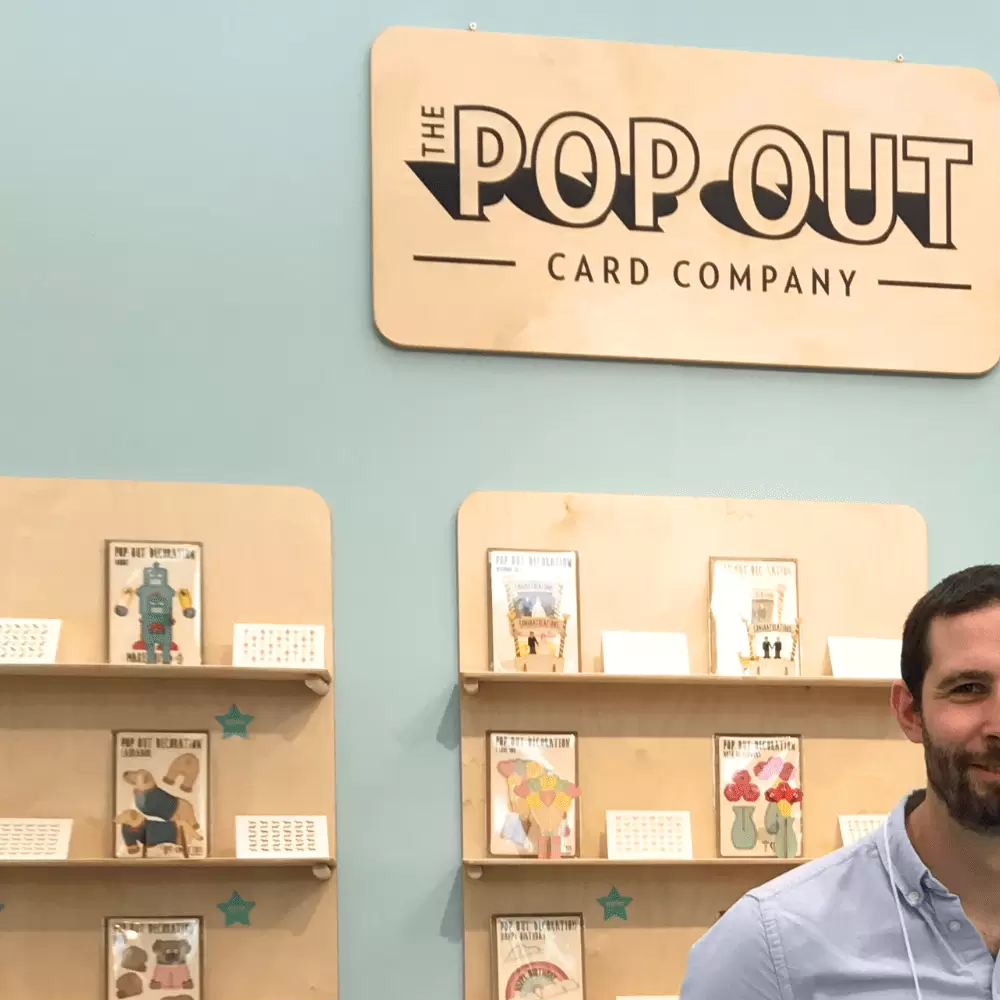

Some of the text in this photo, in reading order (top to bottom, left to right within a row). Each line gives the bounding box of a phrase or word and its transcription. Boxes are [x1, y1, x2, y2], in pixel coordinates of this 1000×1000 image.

[421, 105, 445, 157] THE
[453, 104, 974, 250] POP OUT
[547, 253, 857, 297] CARD COMPANY
